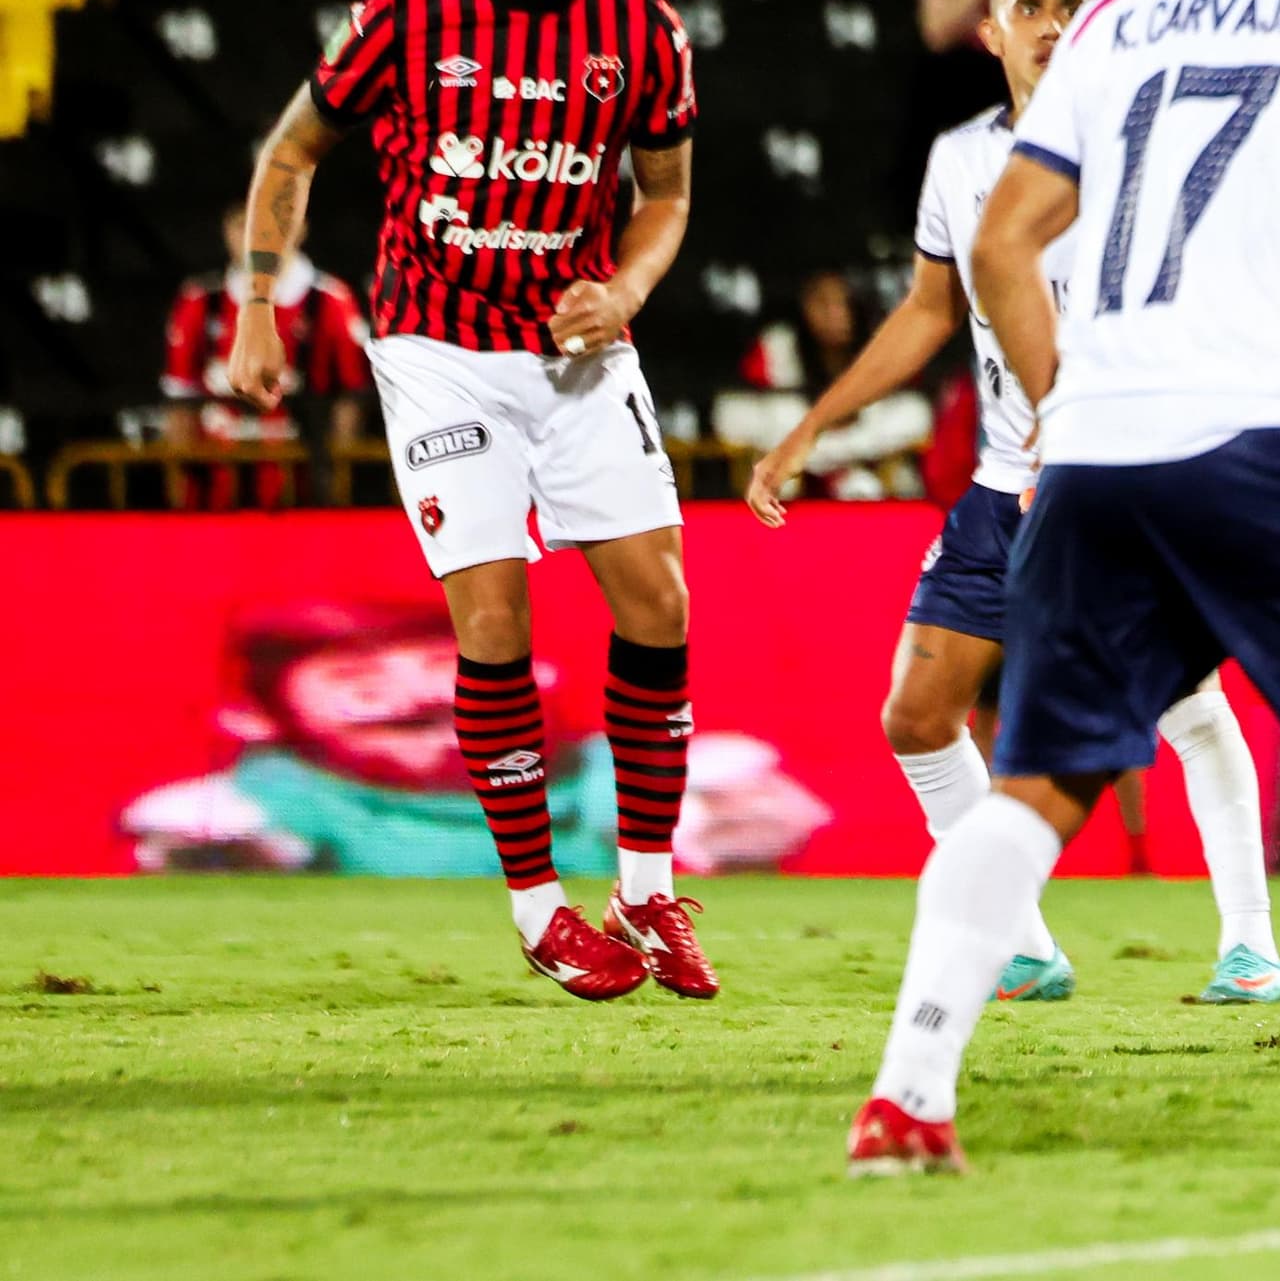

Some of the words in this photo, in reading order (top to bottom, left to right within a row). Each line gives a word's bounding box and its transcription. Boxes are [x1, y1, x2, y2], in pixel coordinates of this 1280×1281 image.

[1112, 13, 1140, 51] K.
[519, 77, 567, 102] BAC
[487, 136, 607, 185] kölbi
[441, 221, 584, 256] medismart
[411, 426, 482, 466] ABUS
